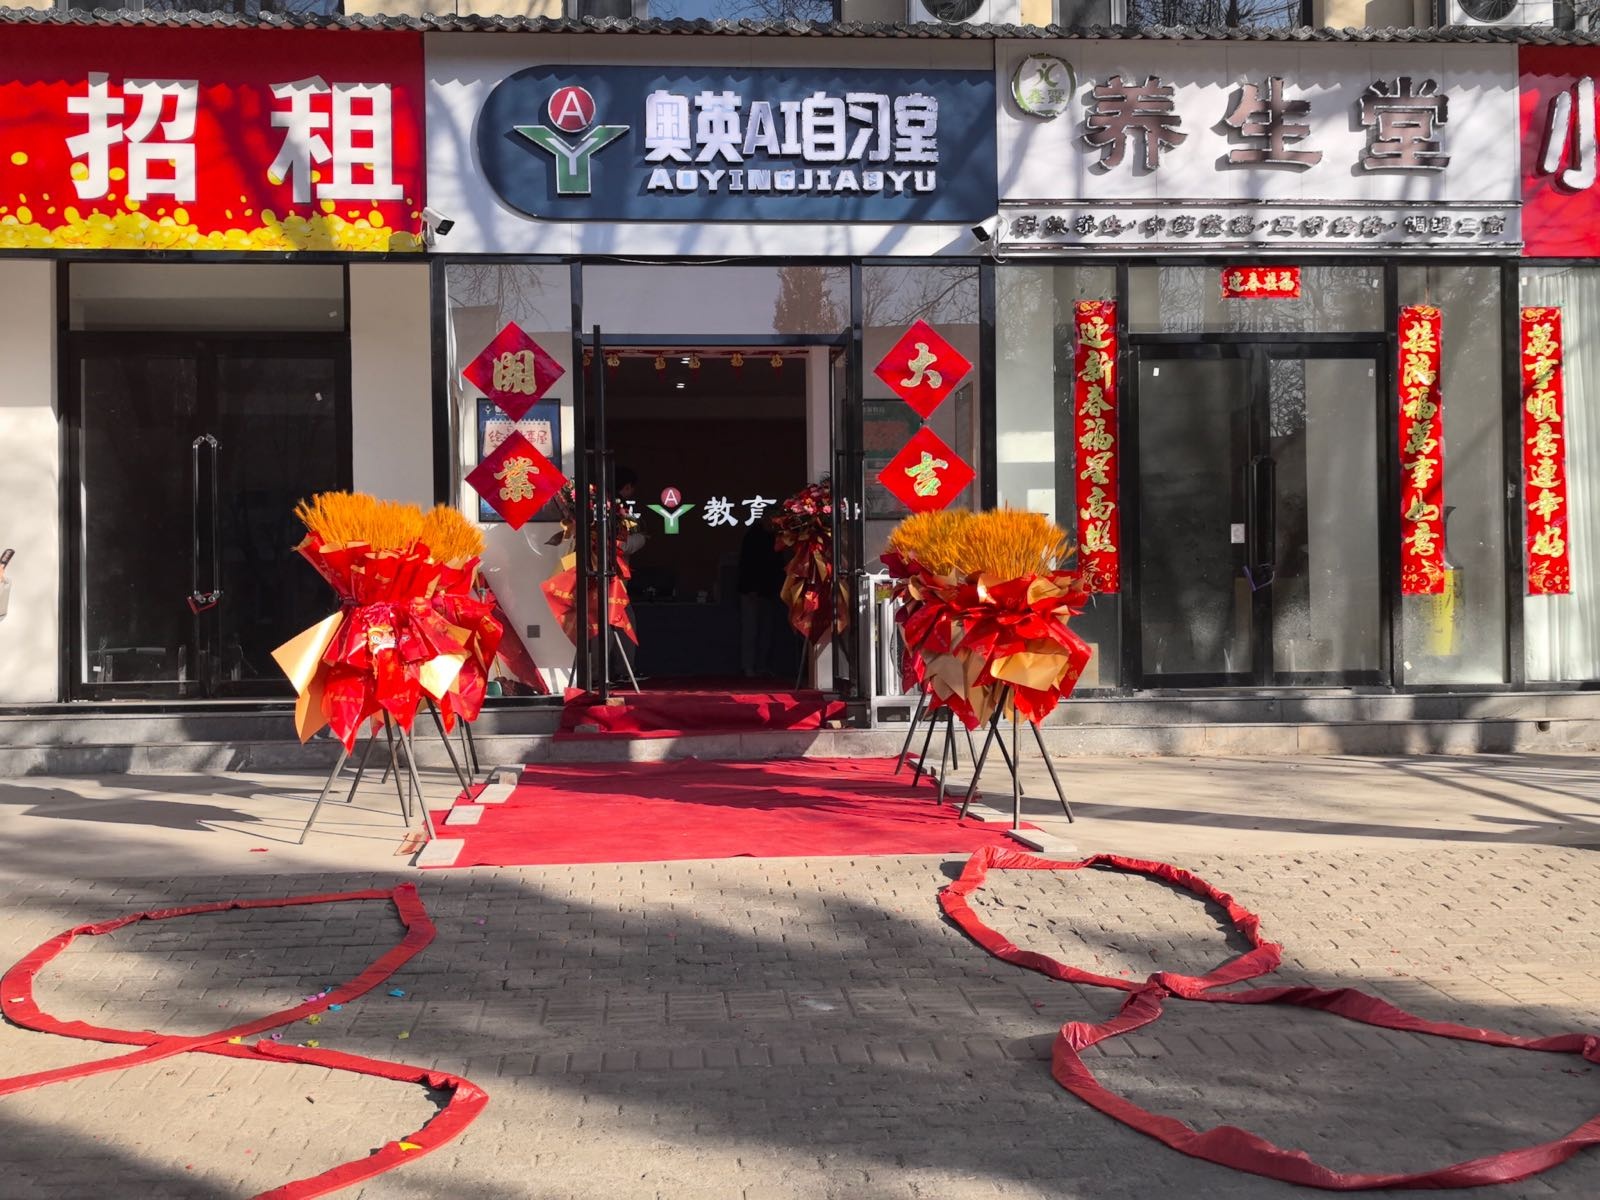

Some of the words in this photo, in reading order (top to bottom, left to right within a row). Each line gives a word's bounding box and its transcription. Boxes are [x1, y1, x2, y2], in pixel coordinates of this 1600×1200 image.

[556, 90, 588, 126] A
[1082, 75, 1450, 172] 养生堂
[65, 72, 404, 203] 招租
[493, 350, 537, 395] 開
[900, 342, 943, 389] 大
[1078, 316, 1116, 555] 迎新春福星高照
[904, 451, 949, 497] 吉
[702, 495, 777, 527] 教育
